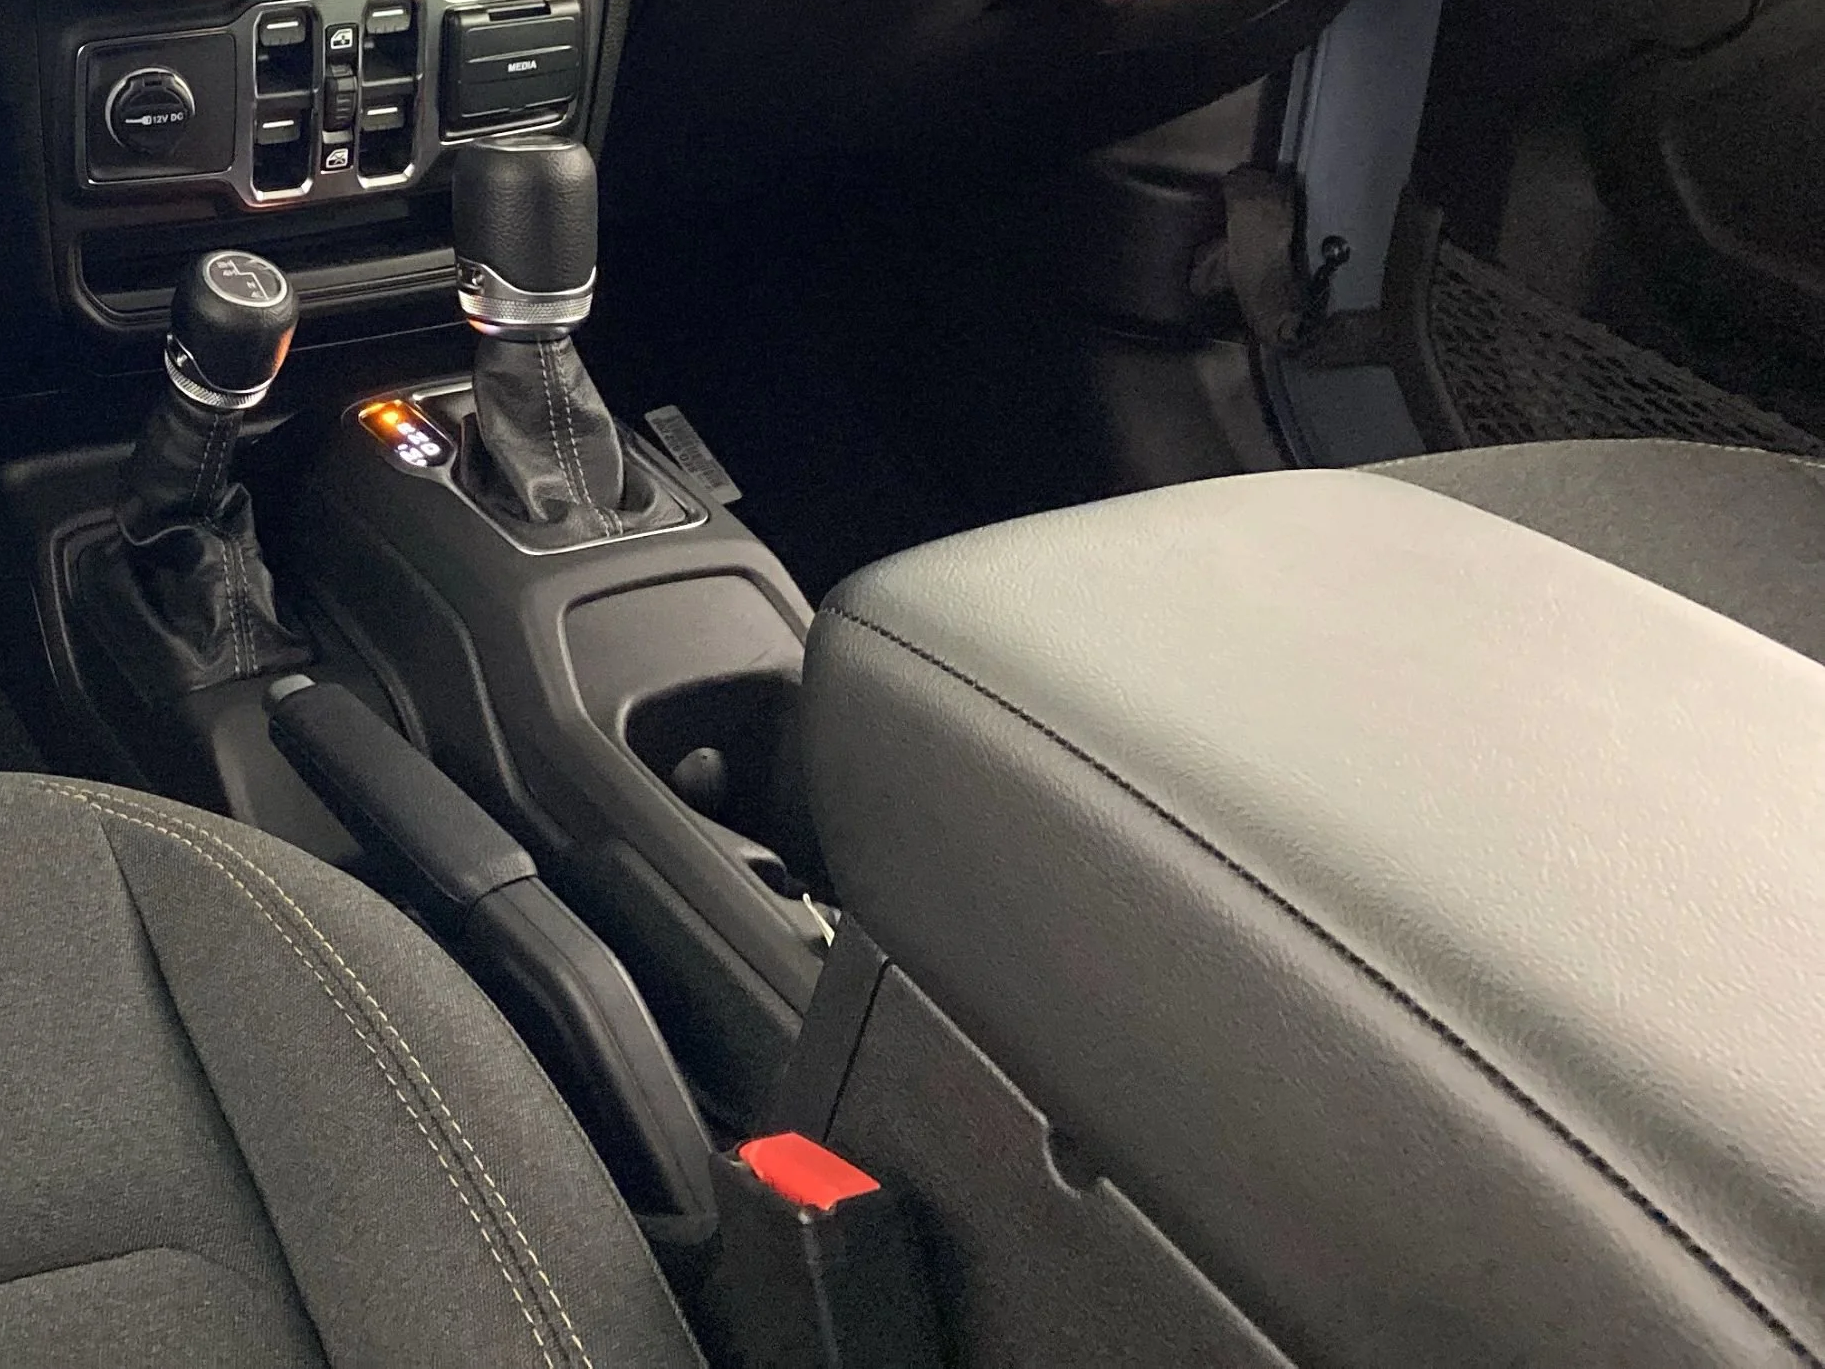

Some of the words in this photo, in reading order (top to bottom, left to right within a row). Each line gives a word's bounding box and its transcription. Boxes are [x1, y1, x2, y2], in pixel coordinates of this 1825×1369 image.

[507, 59, 537, 73] MEDIA
[153, 113, 169, 124] 12V
[170, 112, 184, 122] DC
